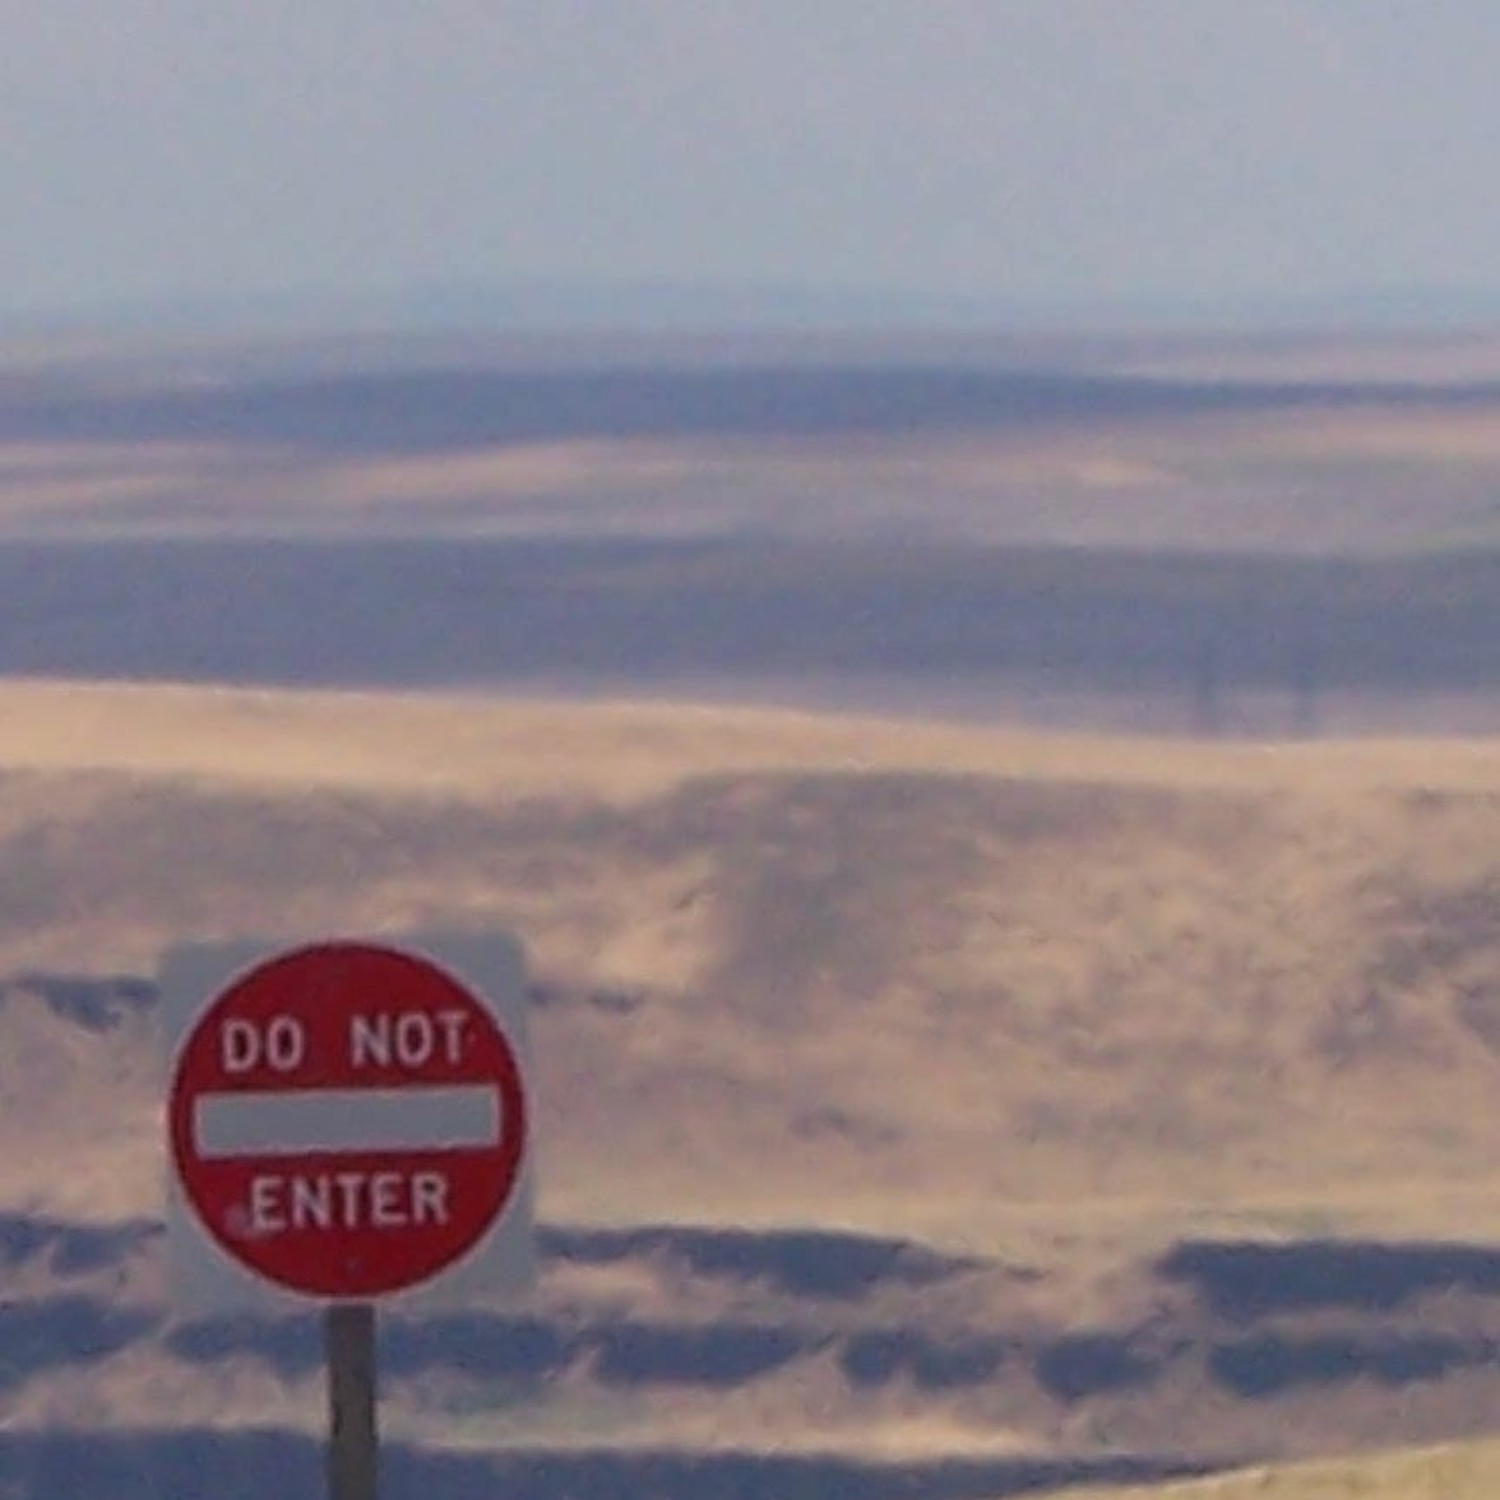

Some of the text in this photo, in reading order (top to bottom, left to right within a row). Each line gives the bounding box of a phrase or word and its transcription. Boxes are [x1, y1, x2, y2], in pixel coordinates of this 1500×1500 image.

[221, 1010, 470, 1073] DO NOT
[251, 1170, 448, 1230] ENTER
